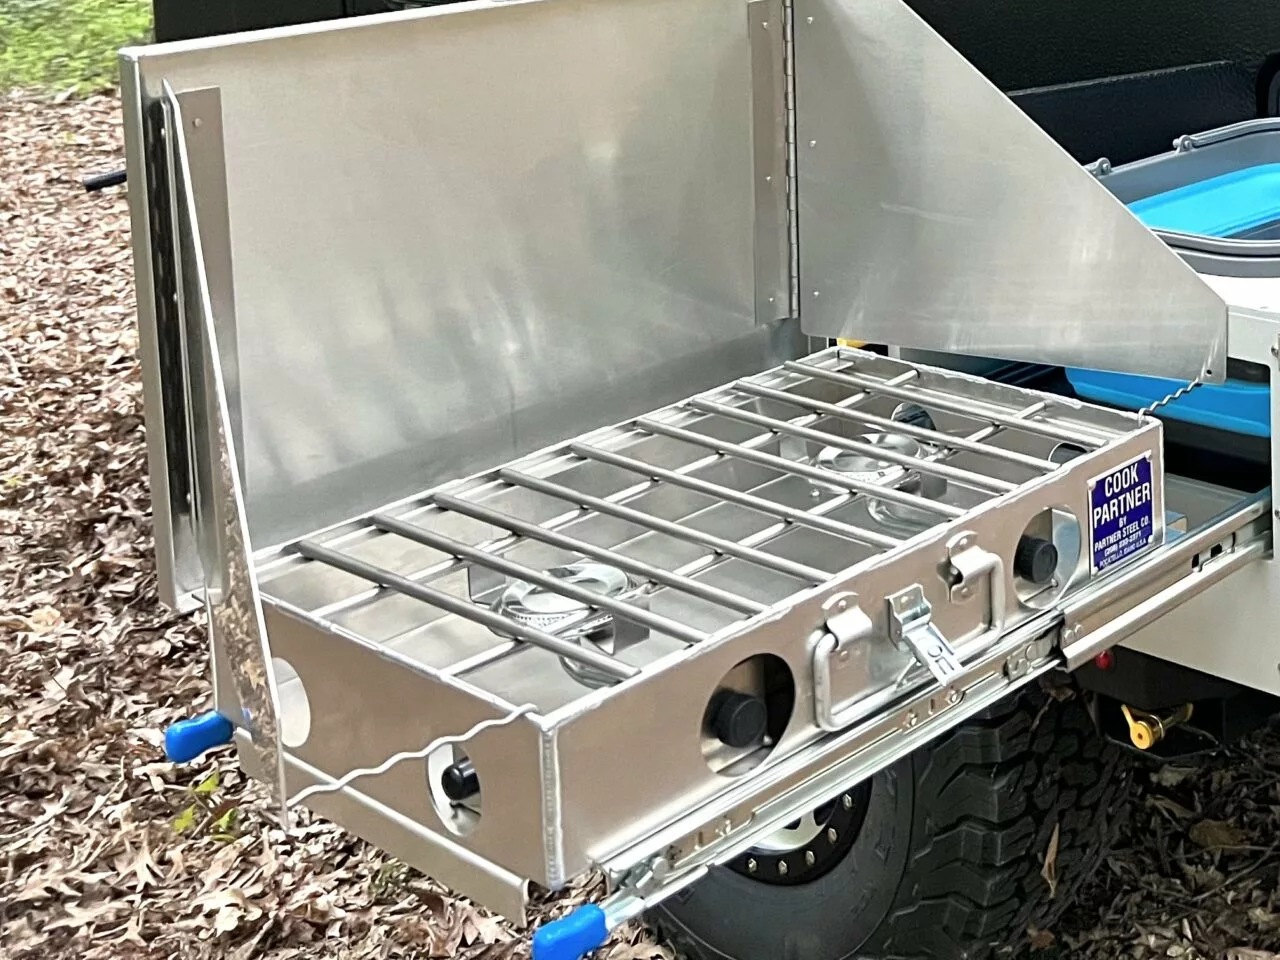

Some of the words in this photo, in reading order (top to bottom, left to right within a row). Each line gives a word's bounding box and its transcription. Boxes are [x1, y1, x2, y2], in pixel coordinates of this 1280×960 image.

[1105, 463, 1139, 497] COOK
[1094, 482, 1151, 528] PARTNER
[1095, 531, 1121, 552] PARTNER
[1122, 521, 1139, 539] STEEL
[1119, 516, 1127, 528] BY
